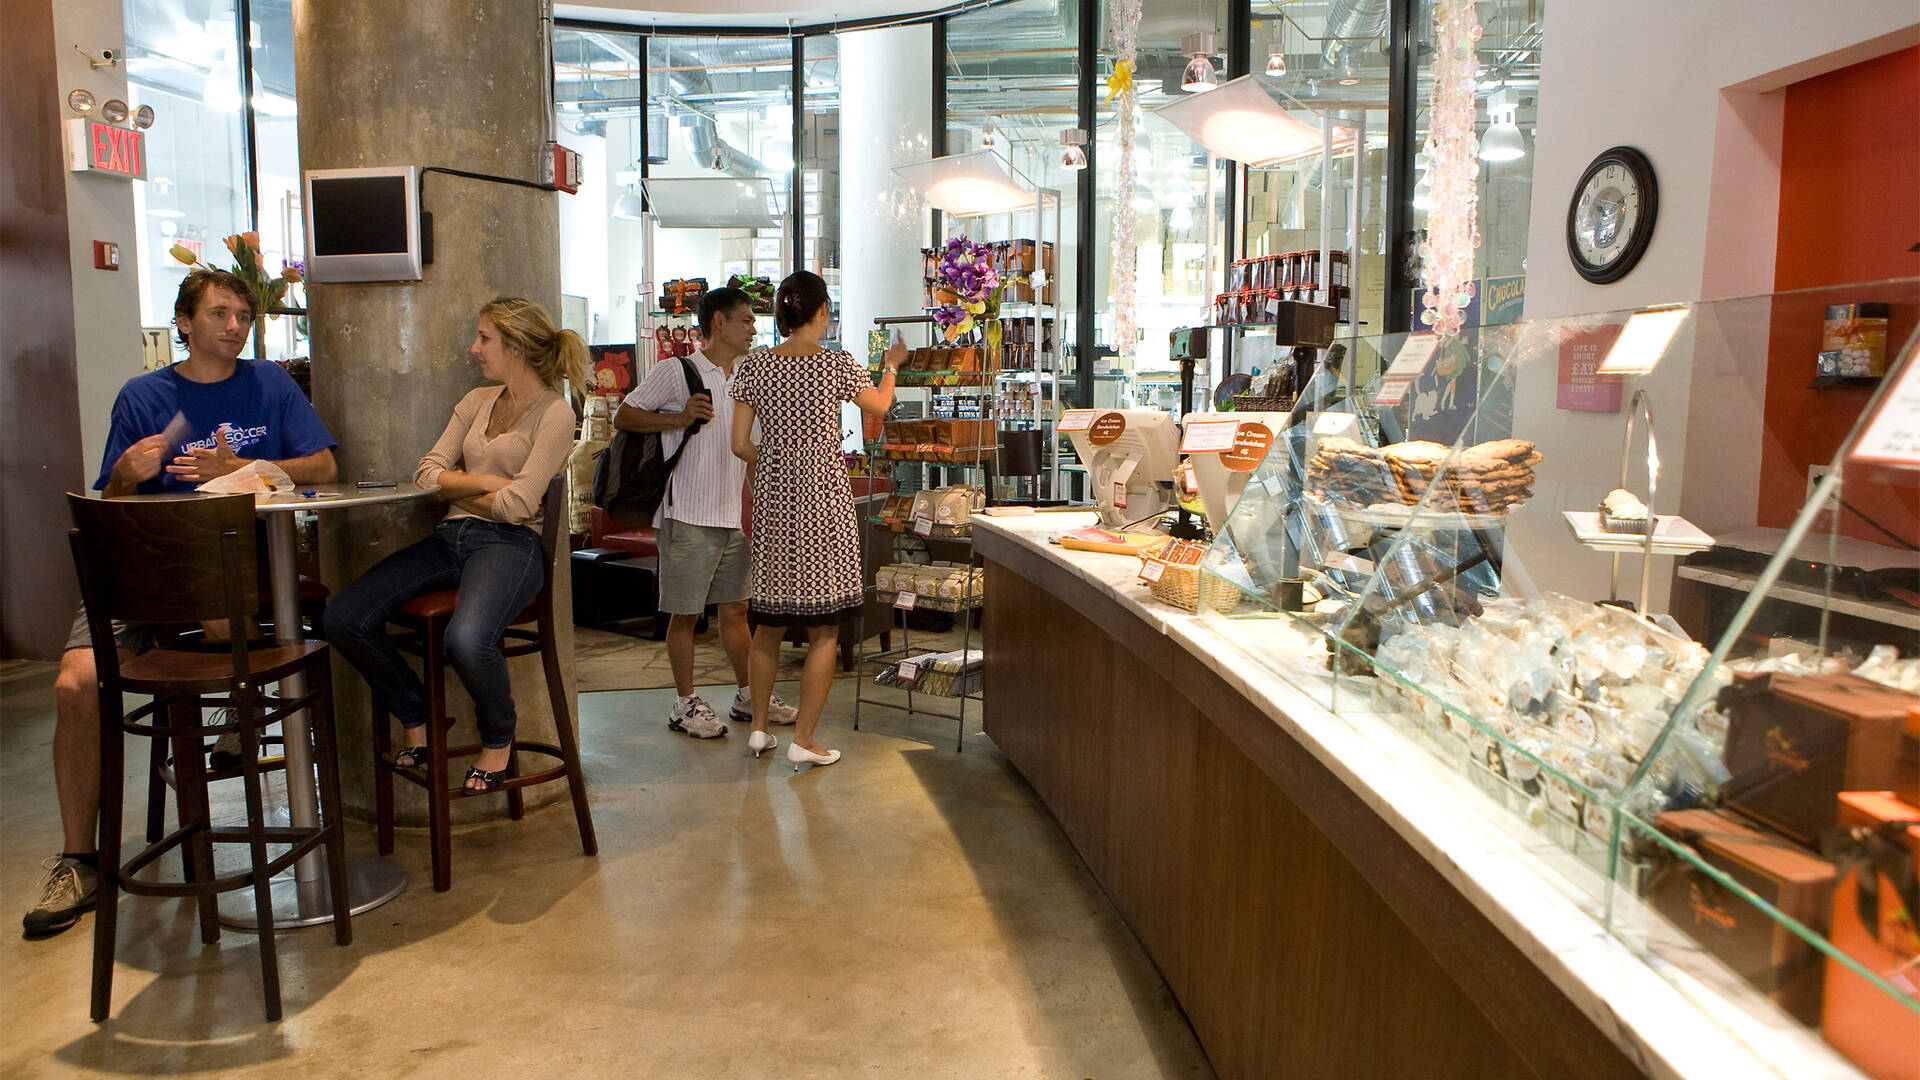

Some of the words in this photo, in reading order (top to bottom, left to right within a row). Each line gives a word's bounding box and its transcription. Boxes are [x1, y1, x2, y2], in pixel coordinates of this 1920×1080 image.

[92, 121, 142, 177] EXIT
[1606, 166, 1615, 180] 12
[175, 239, 203, 265] IT
[1572, 363, 1597, 376] EAT
[224, 426, 267, 444] SOCCER
[1246, 430, 1267, 439] Cream
[1235, 438, 1266, 449] ndwiches
